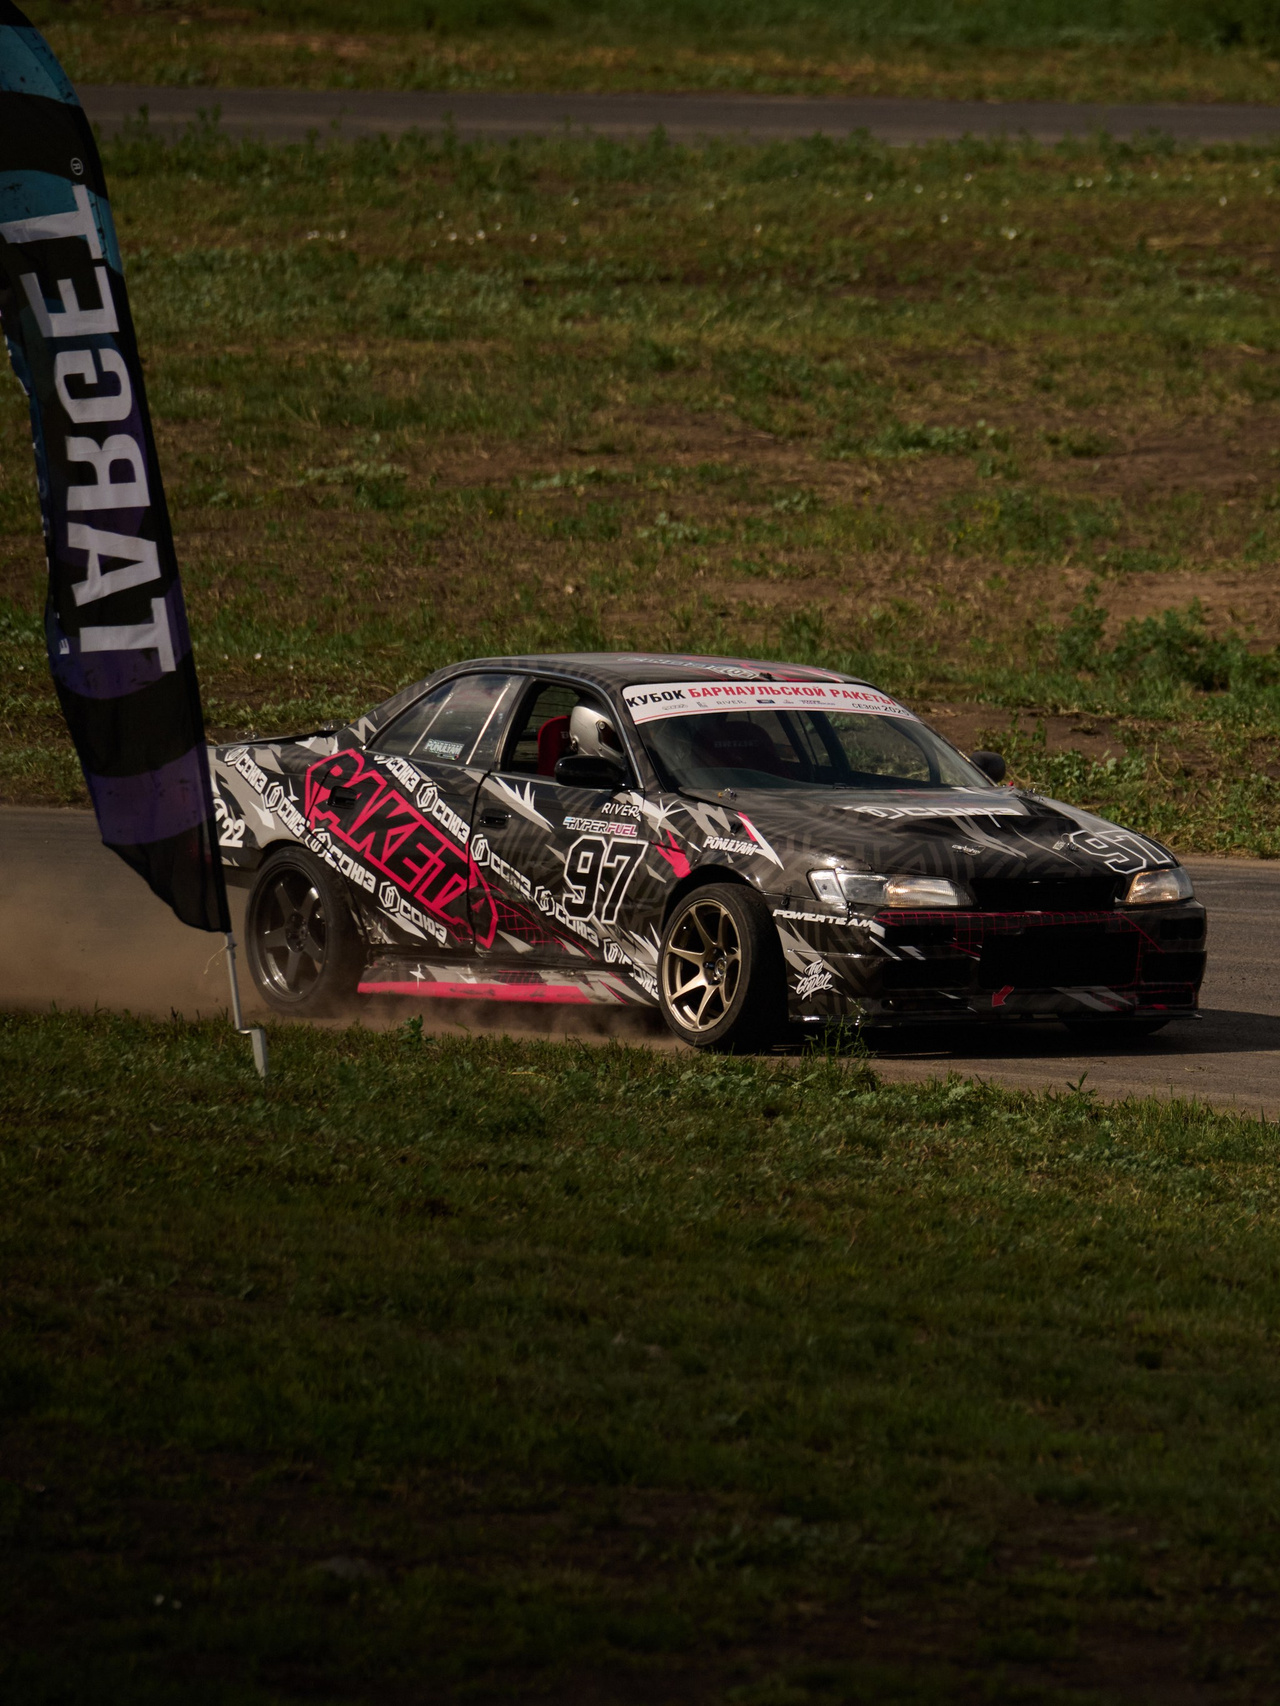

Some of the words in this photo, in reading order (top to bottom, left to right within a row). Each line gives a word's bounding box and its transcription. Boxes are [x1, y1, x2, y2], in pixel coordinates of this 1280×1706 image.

[626, 689, 686, 708] КУБОК
[688, 686, 826, 698] БАРНАУЛЬСКОЙ
[829, 689, 896, 706] РАКЕТЫ
[851, 703, 881, 711] СЕЗОН
[1069, 829, 1172, 875] 97
[562, 834, 649, 924] 97
